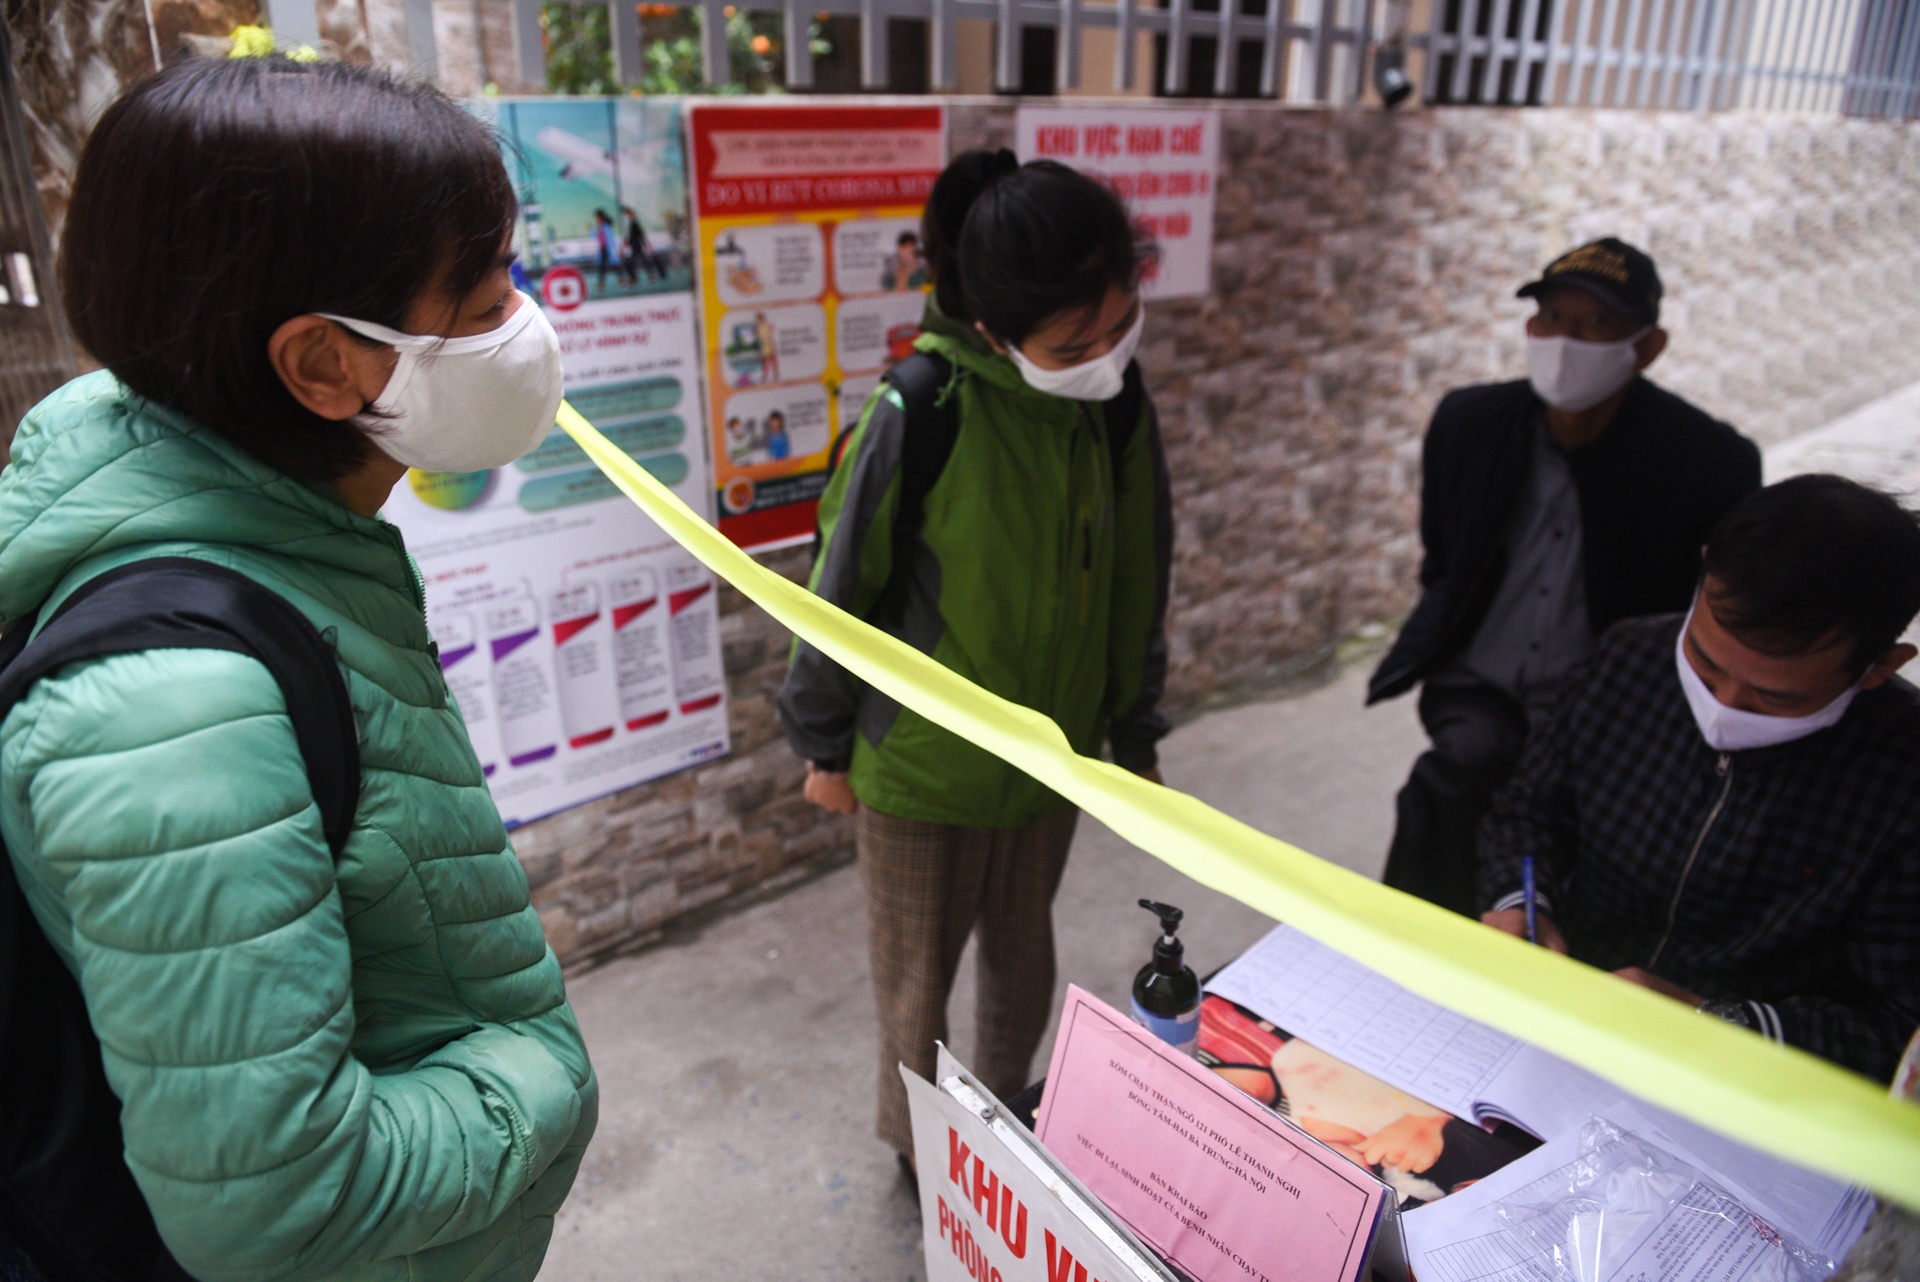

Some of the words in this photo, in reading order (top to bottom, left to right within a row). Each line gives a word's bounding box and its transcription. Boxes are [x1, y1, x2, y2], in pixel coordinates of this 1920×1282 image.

[1036, 125, 1078, 156] KHU
[1196, 1121, 1207, 1133] 121
[1244, 1153, 1274, 1179] THANH
[1277, 1177, 1300, 1199] NGHỊ
[1251, 1177, 1266, 1193] NỘI
[948, 1126, 1028, 1260] KHU
[1122, 1169, 1139, 1186] SINH
[1208, 1234, 1231, 1256] NHÂN
[1168, 1185, 1188, 1206] KHAI
